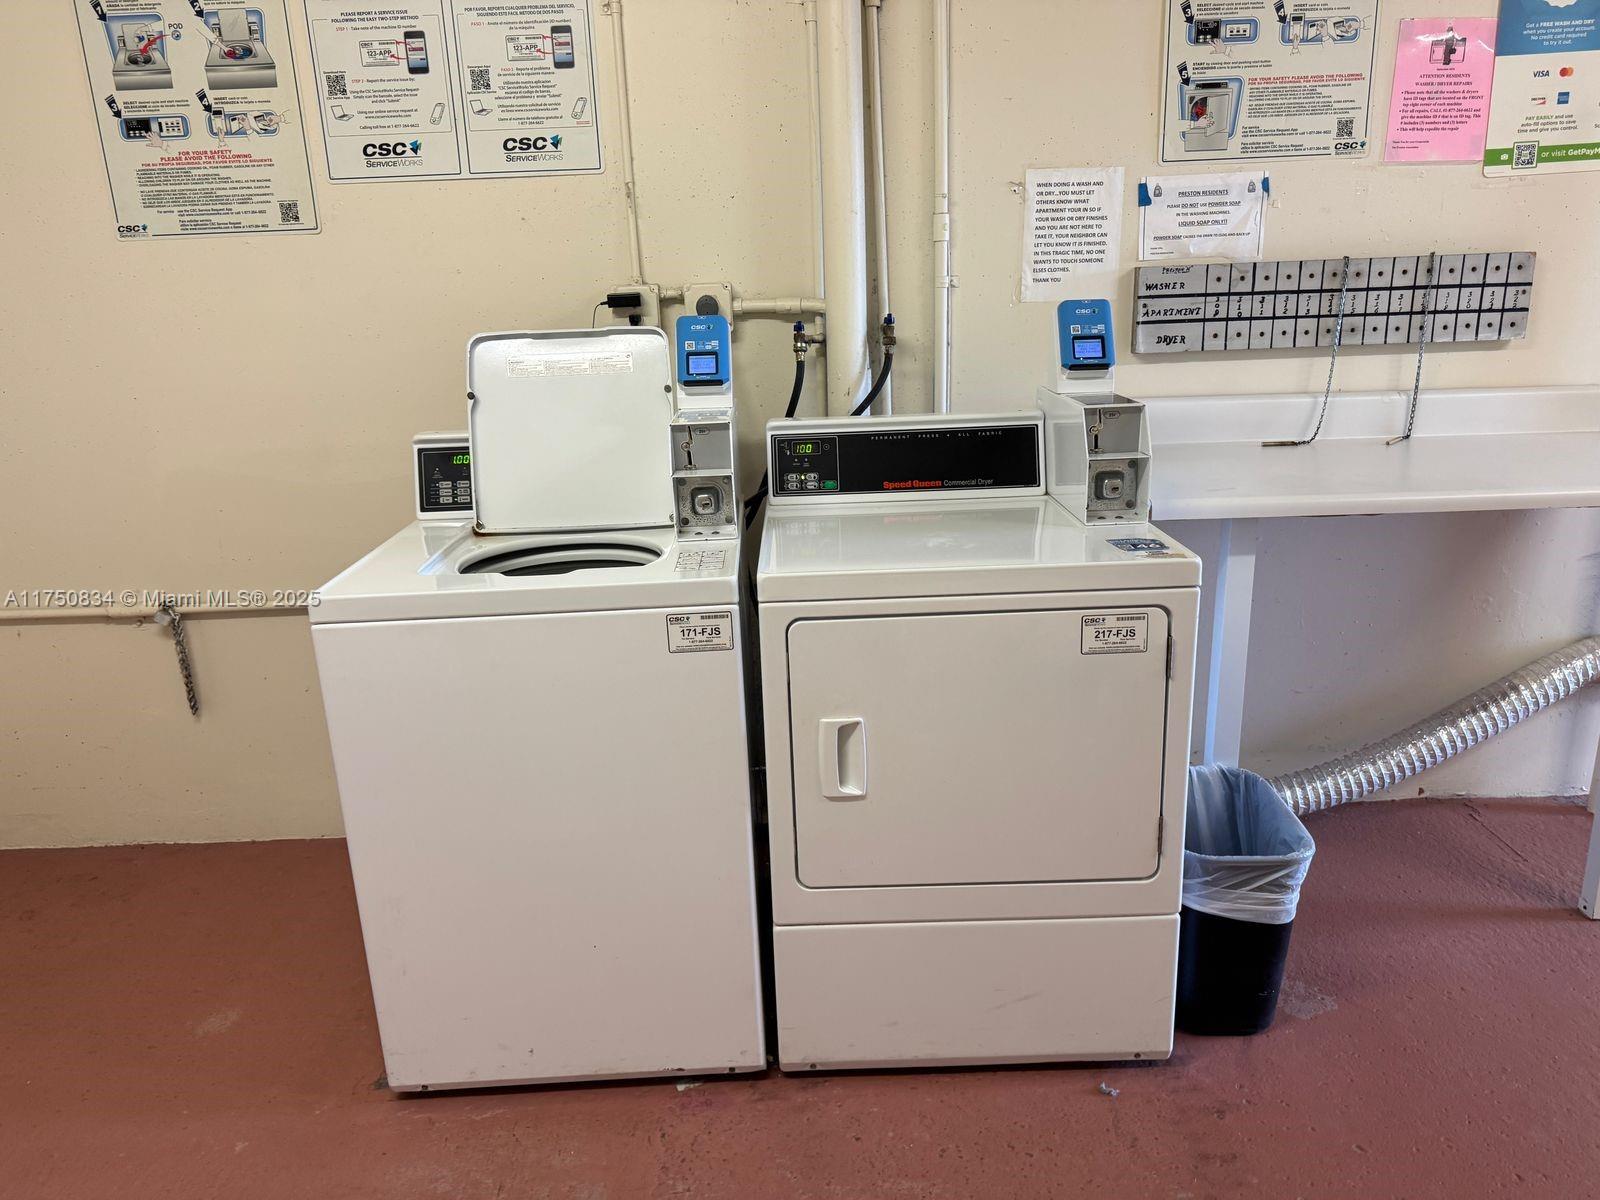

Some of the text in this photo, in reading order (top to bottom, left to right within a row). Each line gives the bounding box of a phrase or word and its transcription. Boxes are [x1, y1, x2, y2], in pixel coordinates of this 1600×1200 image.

[1533, 70, 1550, 78] VISA
[503, 137, 547, 151] CSC
[1335, 142, 1358, 150] CSC
[362, 142, 407, 157] CSC
[118, 224, 141, 233] CSC
[1146, 282, 1186, 292] WASHER
[1142, 307, 1201, 318] APARTMENT
[1156, 336, 1186, 345] DRYER
[883, 480, 912, 489] Speed
[913, 480, 942, 488] Queen
[680, 627, 721, 637] 171-FJS
[1095, 629, 1136, 639] 217-FJS
